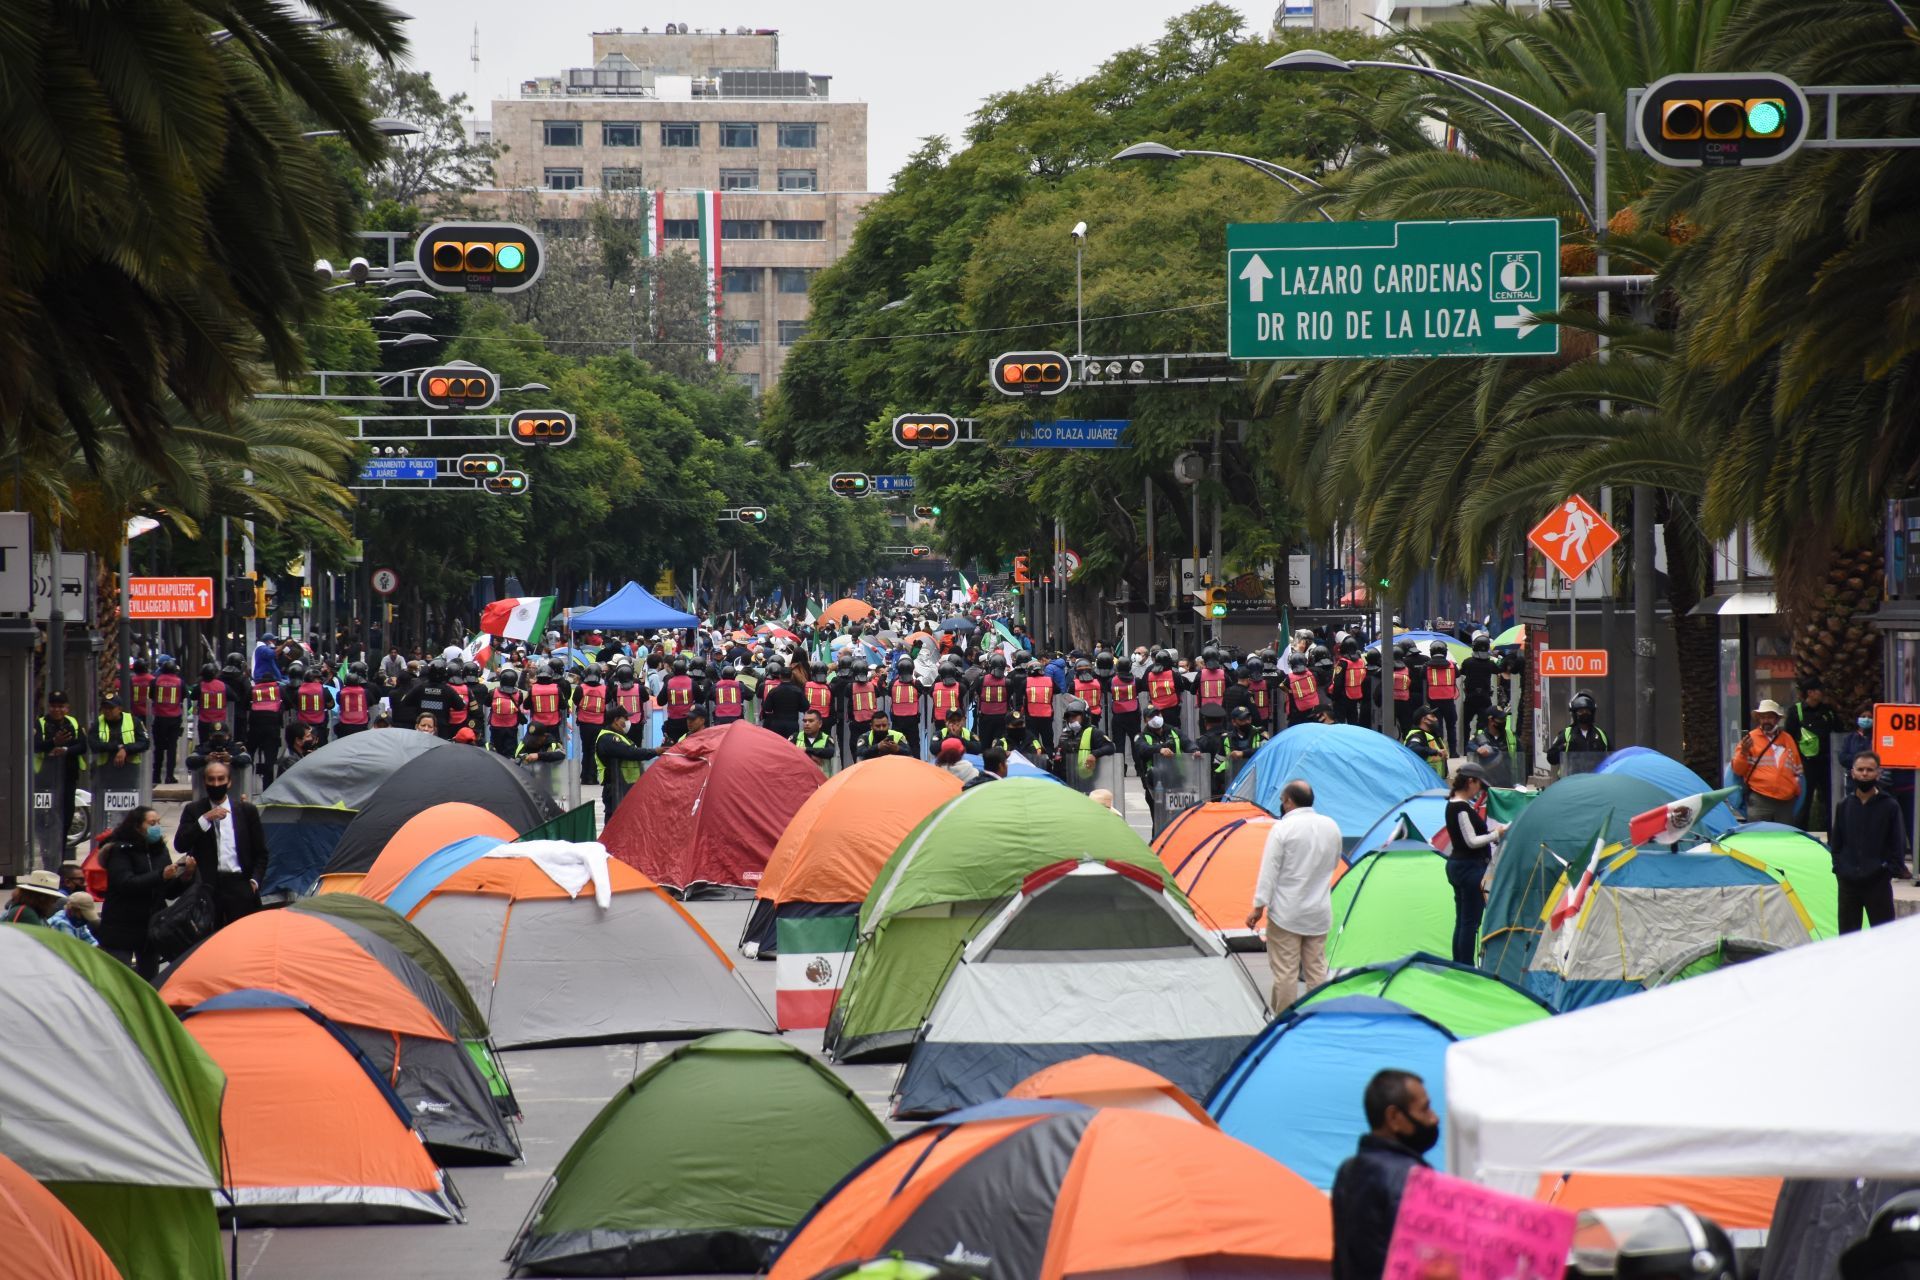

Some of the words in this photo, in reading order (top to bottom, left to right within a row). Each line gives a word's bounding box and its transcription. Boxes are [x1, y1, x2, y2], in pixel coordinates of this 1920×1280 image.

[1706, 143, 1738, 152] CDMX
[1506, 254, 1525, 263] EJE
[1280, 264, 1362, 296] LAZARO
[1374, 262, 1483, 295] CARDENAS
[1495, 291, 1535, 299] CENTRAL
[1257, 312, 1284, 341] DR
[1297, 311, 1333, 341] RIO
[1346, 310, 1373, 339] DE
[1385, 310, 1413, 339] LA
[1424, 308, 1482, 338] LOZA
[1056, 428, 1083, 440] PLAZA
[1086, 425, 1118, 440] JUÁREZ
[130, 583, 148, 596] HACIA
[157, 583, 196, 596] CHAPULTEPEC
[1546, 656, 1555, 671] A
[1561, 655, 1584, 671] 100
[1590, 658, 1602, 671] m
[107, 795, 136, 808] POLICIA
